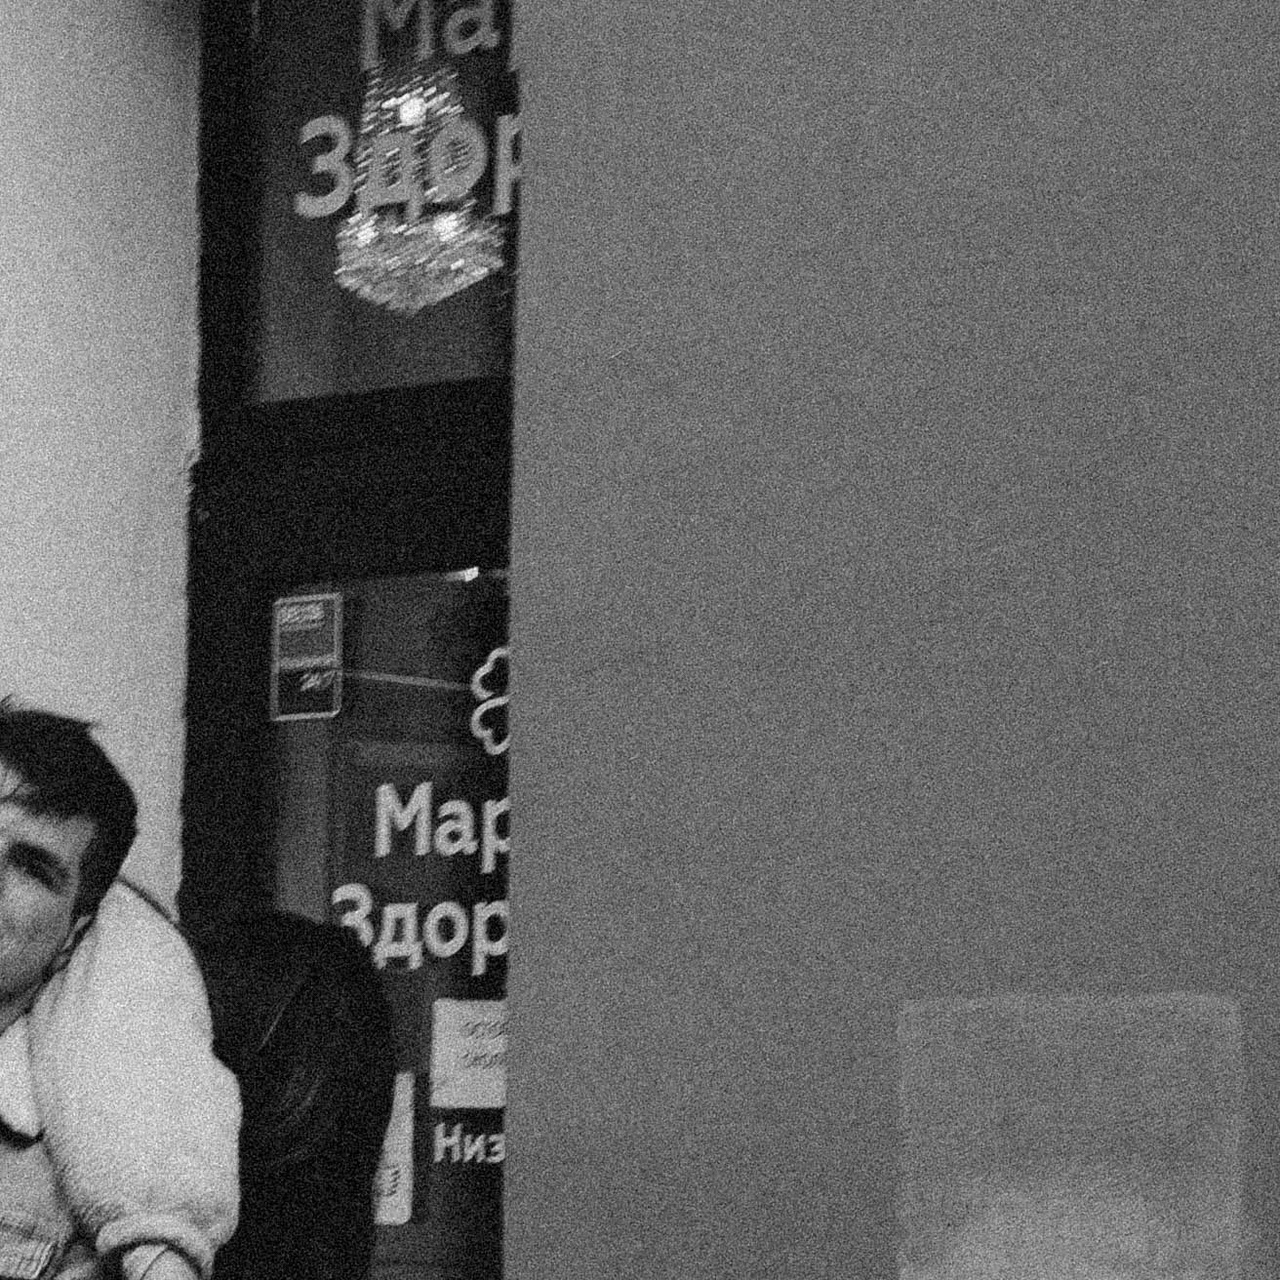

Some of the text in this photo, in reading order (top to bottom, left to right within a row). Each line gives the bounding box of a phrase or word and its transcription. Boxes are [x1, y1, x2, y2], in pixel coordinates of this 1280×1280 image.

[374, 780, 510, 874] Мар
[331, 881, 510, 977] Здор
[433, 1122, 506, 1164] Низ
